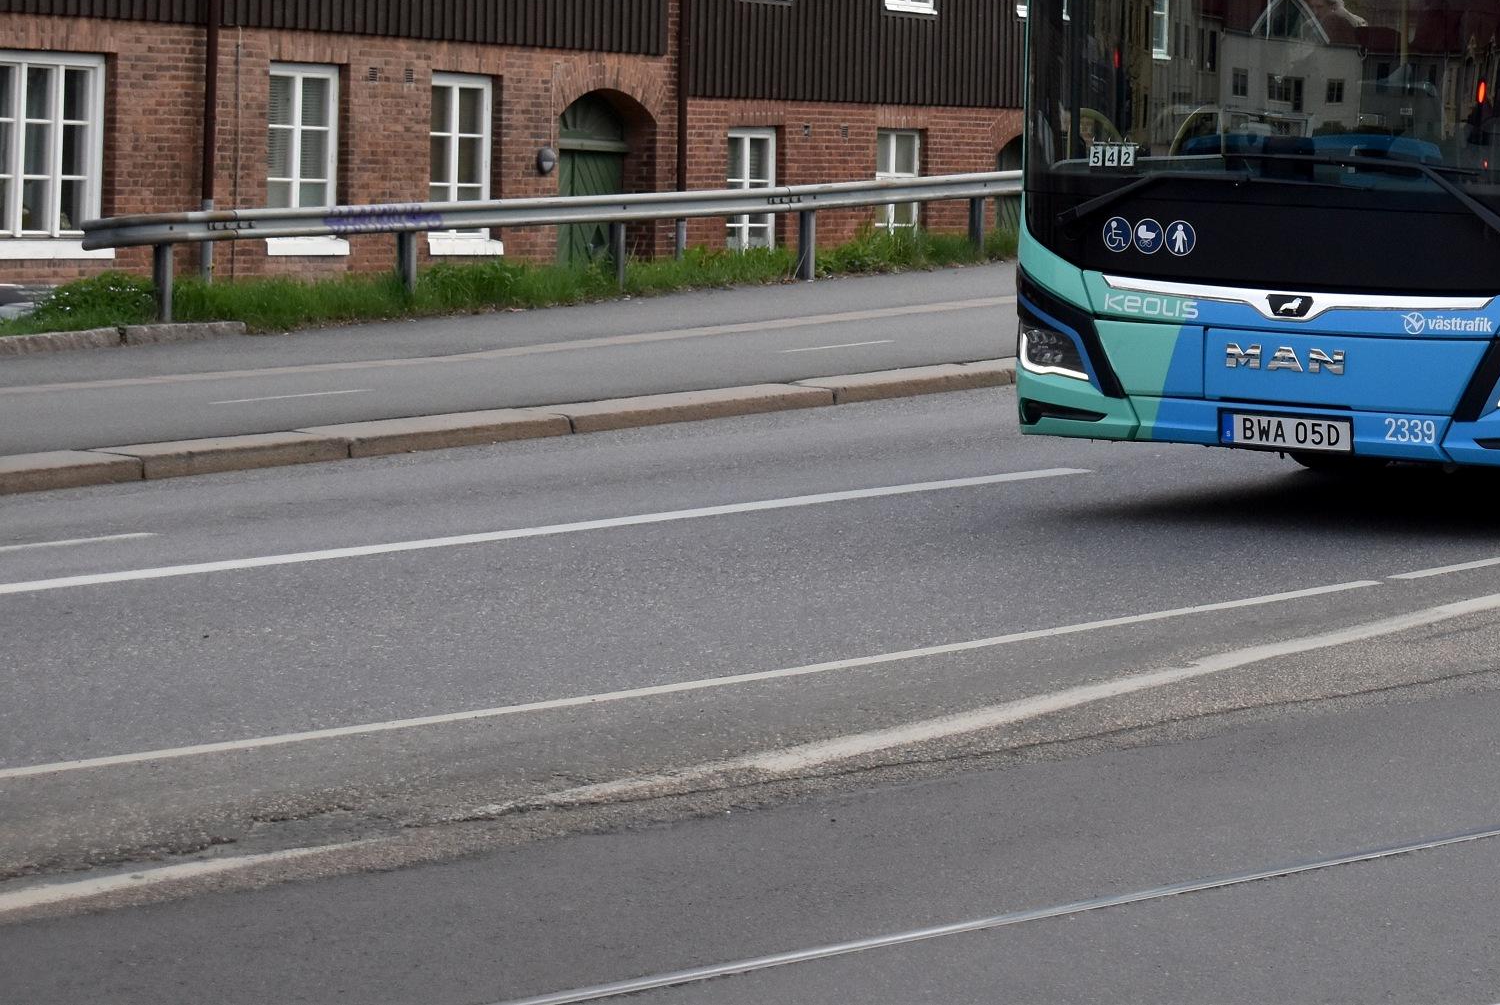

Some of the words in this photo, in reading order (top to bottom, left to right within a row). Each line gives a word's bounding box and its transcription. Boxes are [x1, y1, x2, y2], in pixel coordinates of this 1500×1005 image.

[1427, 315, 1492, 333] västtrafik
[1225, 342, 1346, 375] MAN
[1242, 417, 1286, 444] BWA
[1295, 421, 1340, 447] 05D
[1384, 417, 1436, 444] 2339
